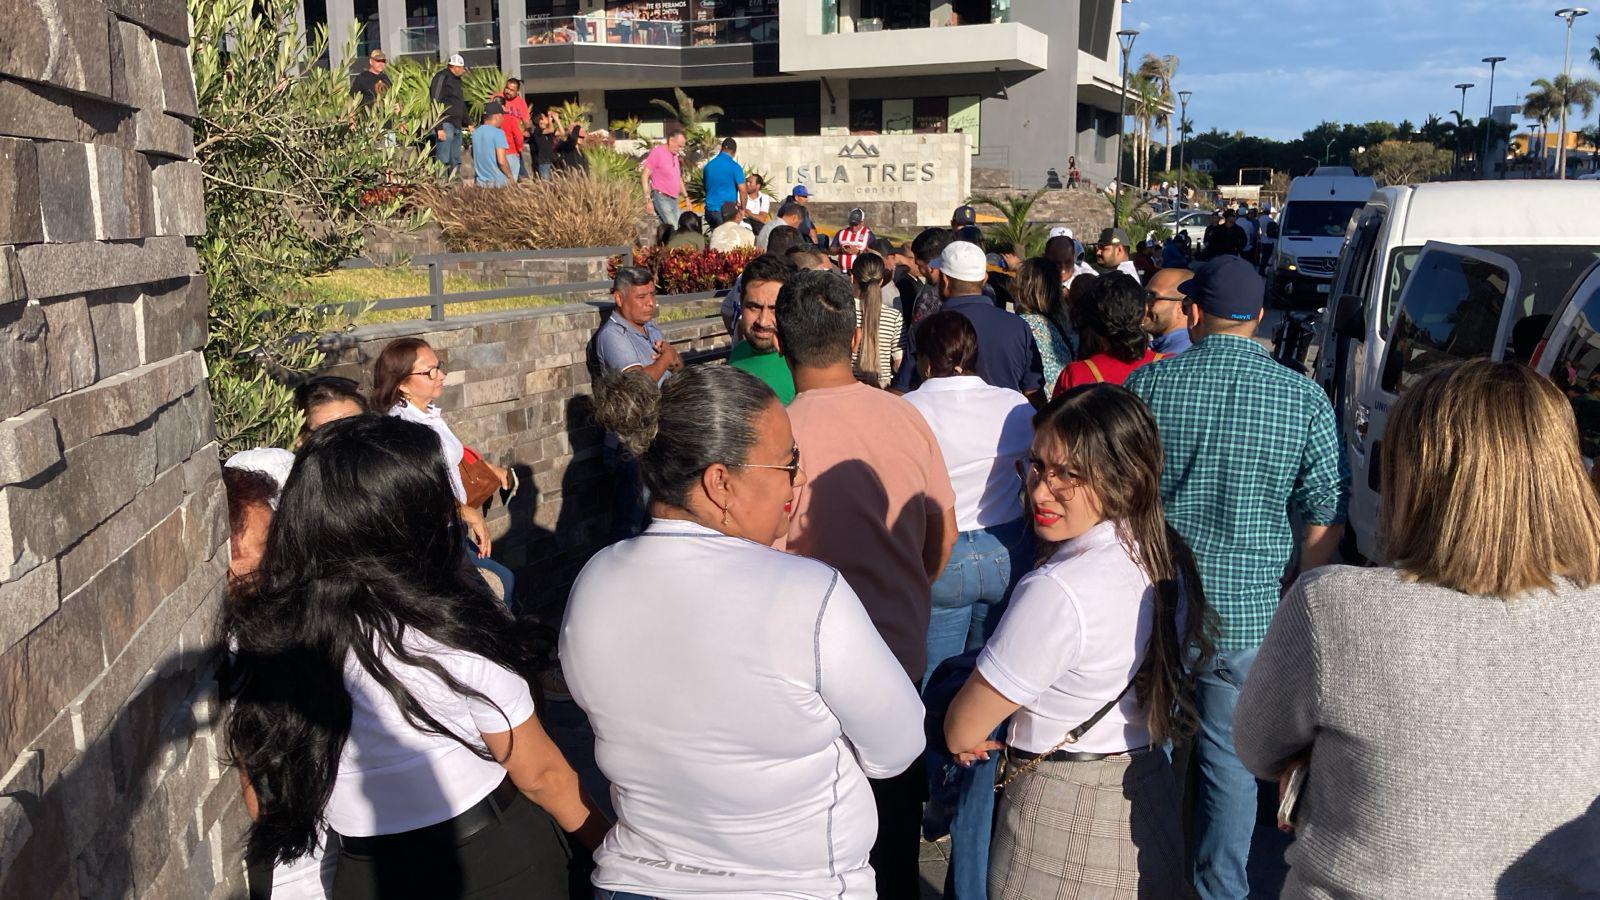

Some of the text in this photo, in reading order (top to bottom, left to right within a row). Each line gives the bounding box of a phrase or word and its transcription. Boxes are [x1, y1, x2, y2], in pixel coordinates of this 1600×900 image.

[786, 162, 936, 184] ISLA TRES
[856, 185, 903, 195] center
